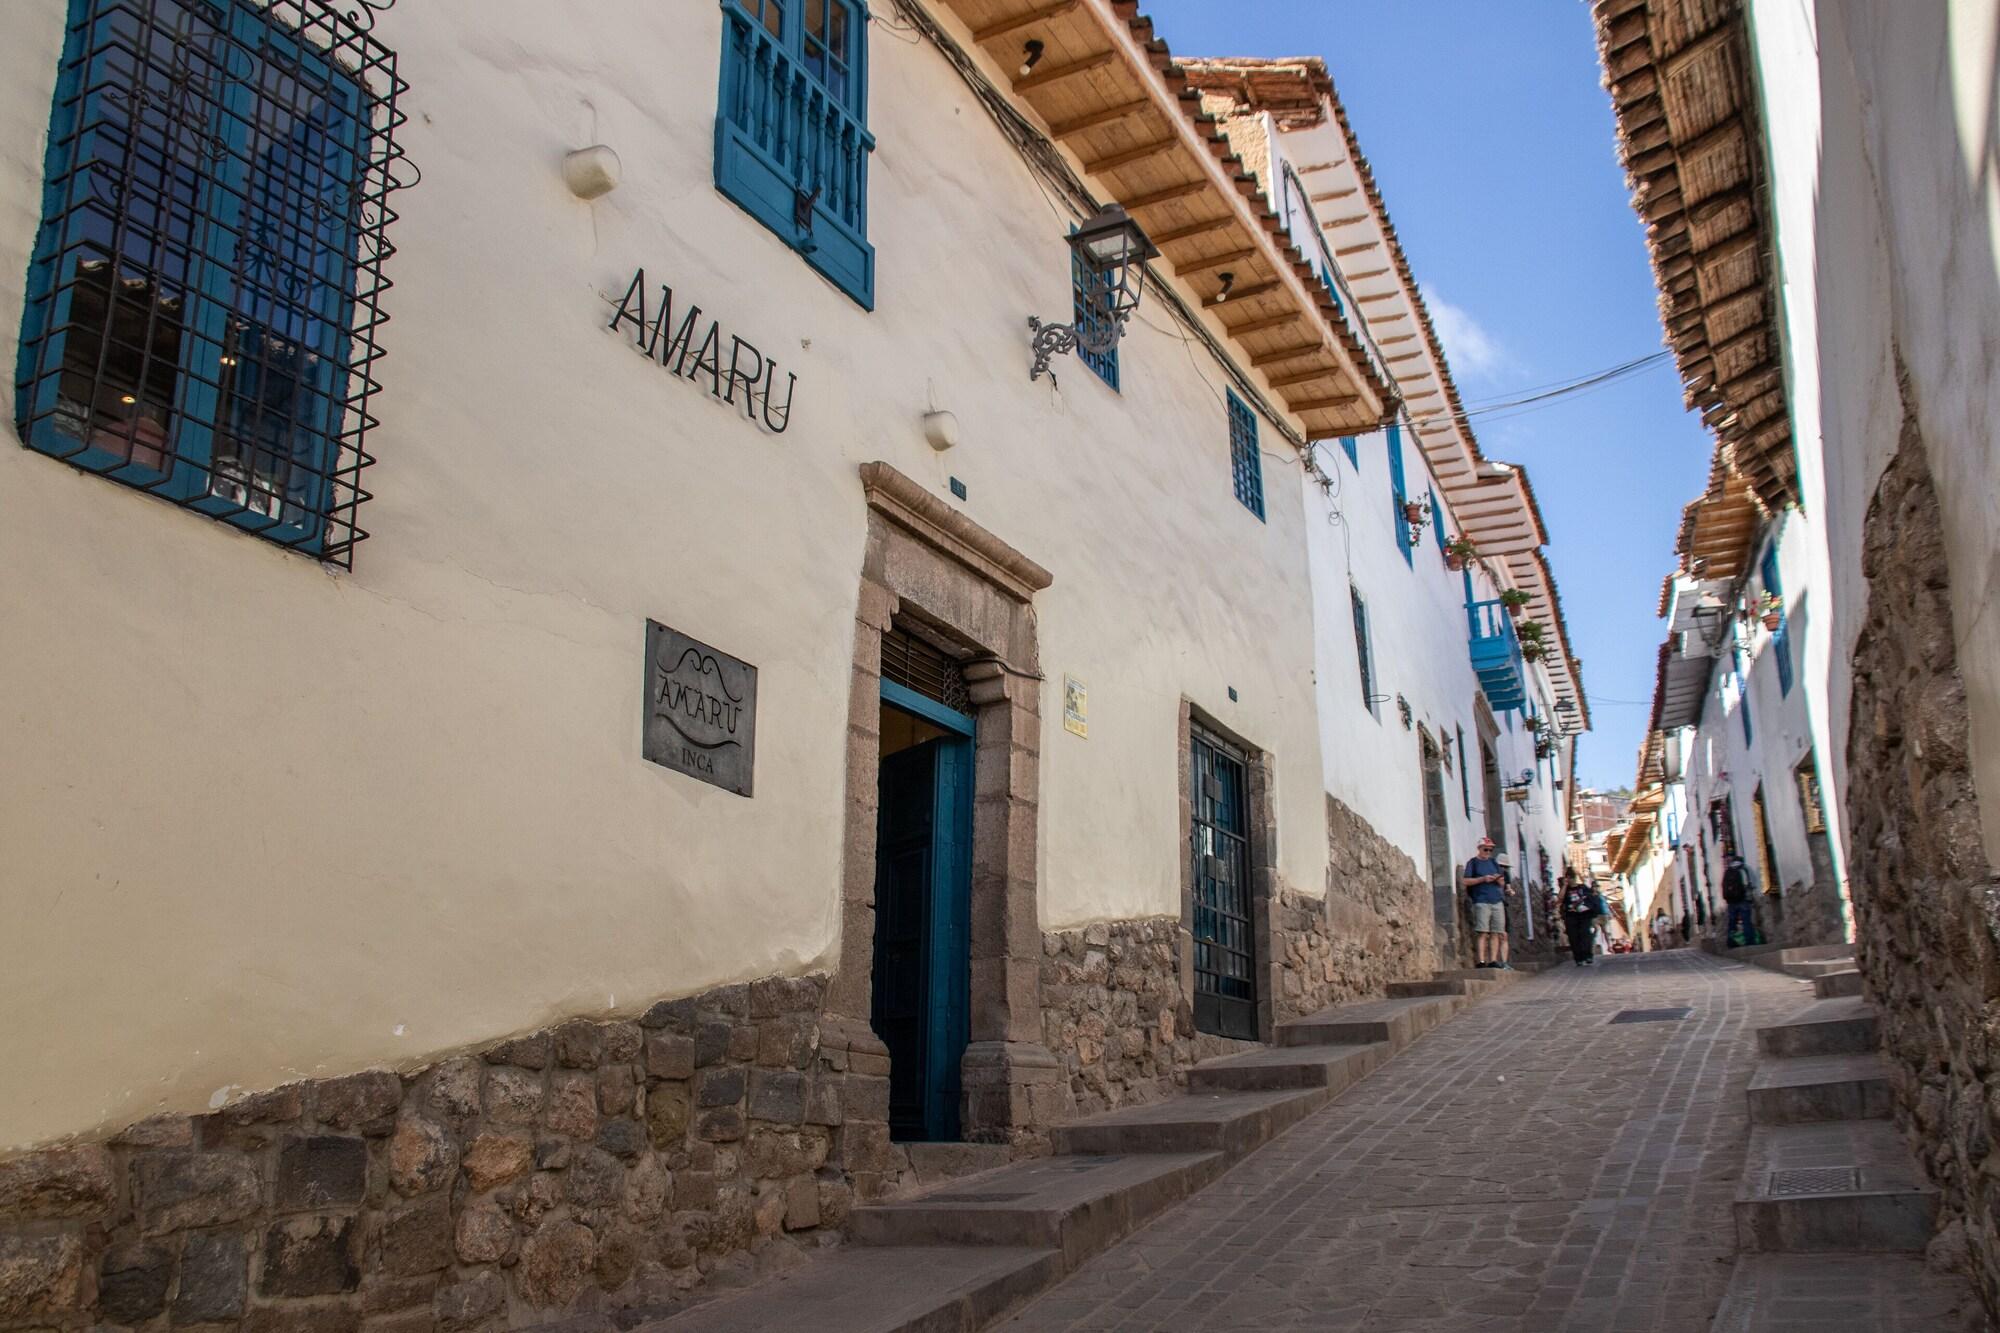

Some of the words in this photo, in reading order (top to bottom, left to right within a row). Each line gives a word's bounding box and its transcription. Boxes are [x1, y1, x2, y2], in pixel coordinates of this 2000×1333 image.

[608, 267, 797, 433] AMARU
[656, 674, 743, 734] AMARU
[681, 748, 714, 774] INCA
